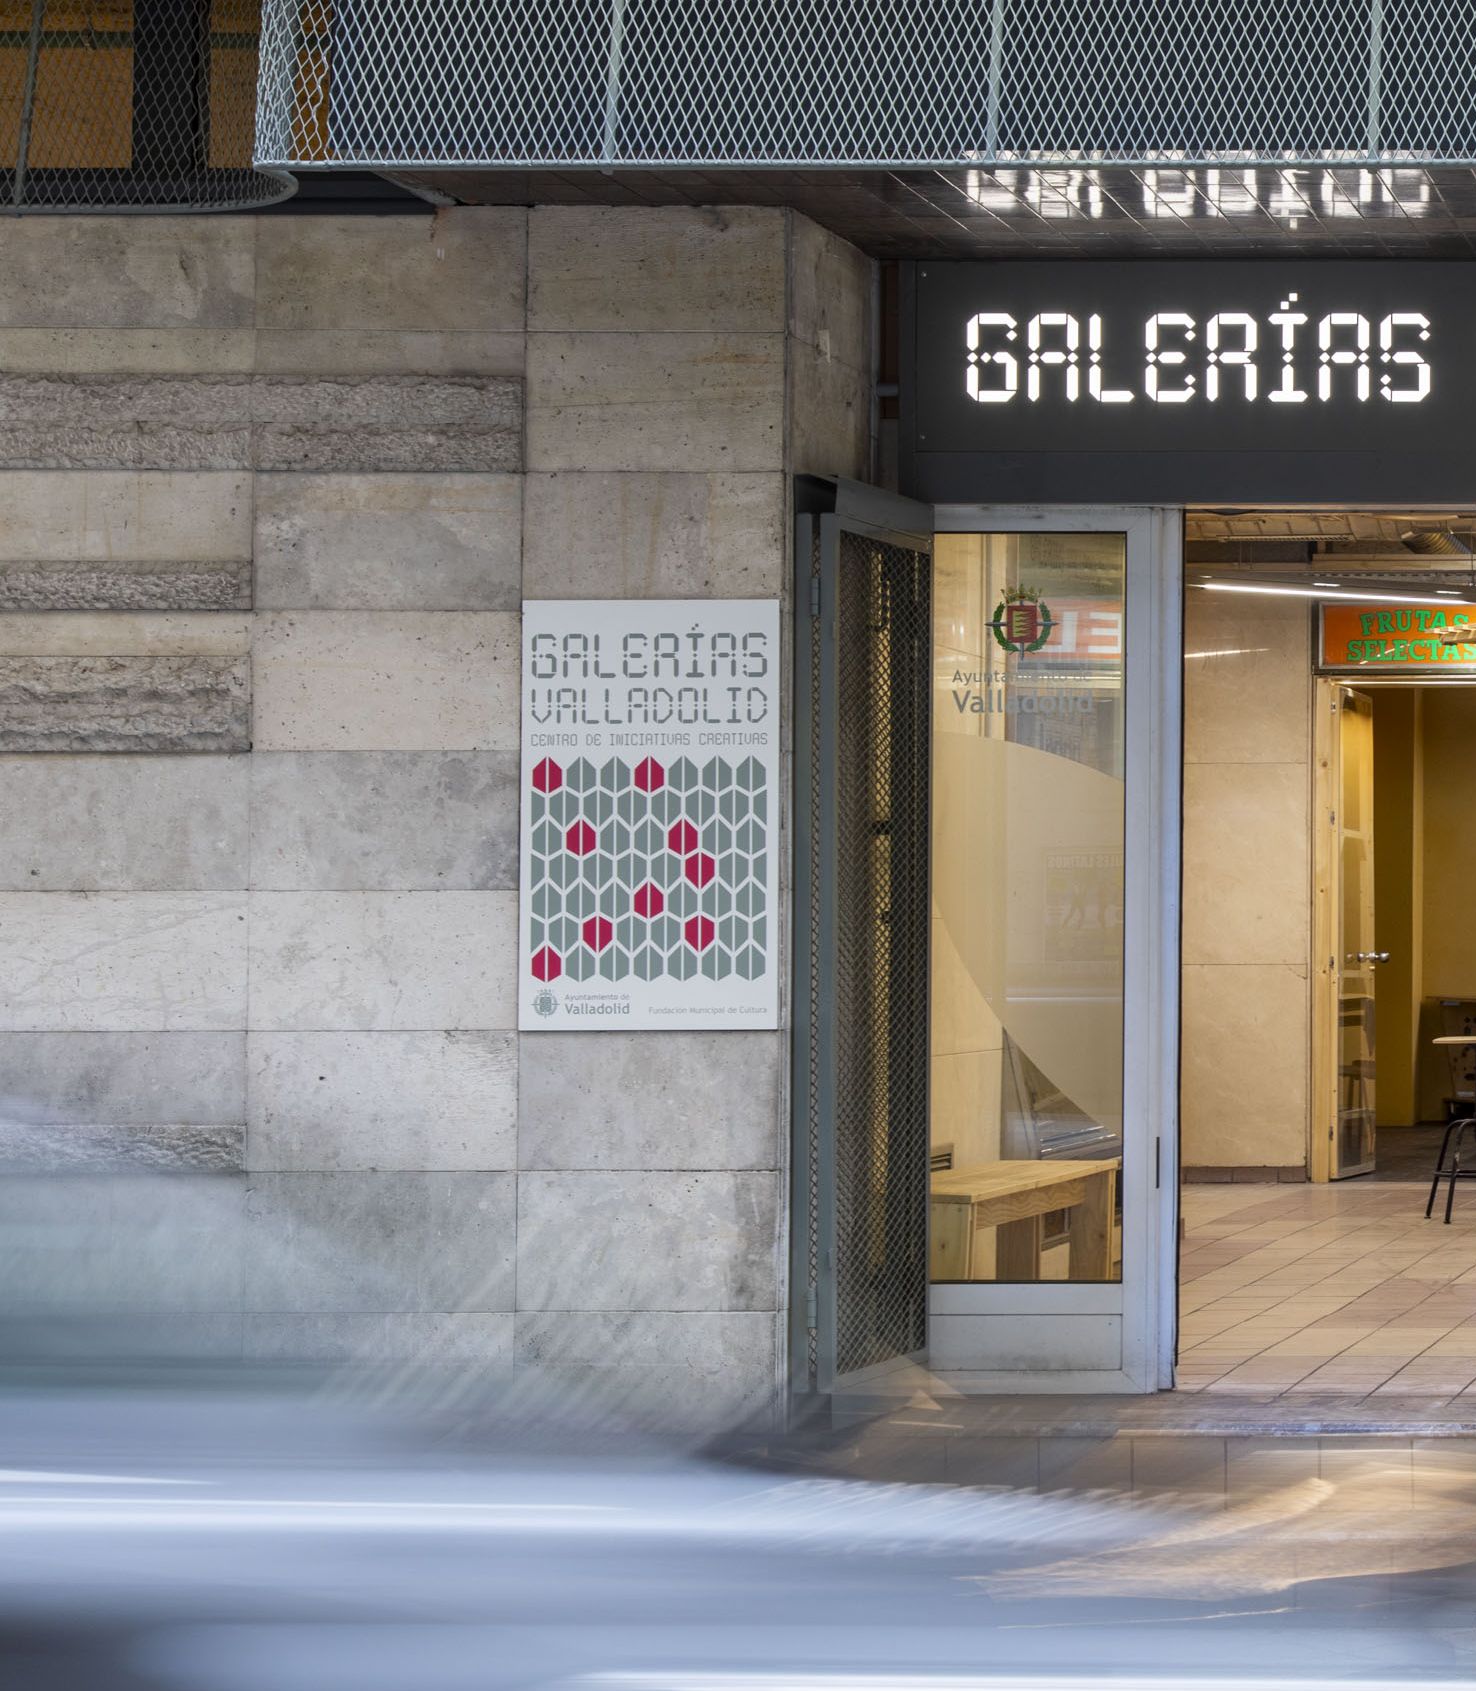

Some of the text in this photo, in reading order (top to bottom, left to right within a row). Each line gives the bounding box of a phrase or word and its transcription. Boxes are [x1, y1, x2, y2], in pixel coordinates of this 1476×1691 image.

[966, 292, 1431, 402] GALERÍAS
[531, 623, 768, 678] GALERÍAS
[531, 687, 768, 724] VALLADOLID
[952, 689, 1093, 714] Valladolid
[530, 732, 768, 746] CENTRO DE INICIATIVAS CREATIVAS
[564, 993, 618, 1001] Ayuntamiento
[564, 1003, 630, 1015] Valladolid
[690, 1006, 725, 1015] Municipal
[728, 1006, 737, 1014] de
[739, 1006, 767, 1014] Cultura
